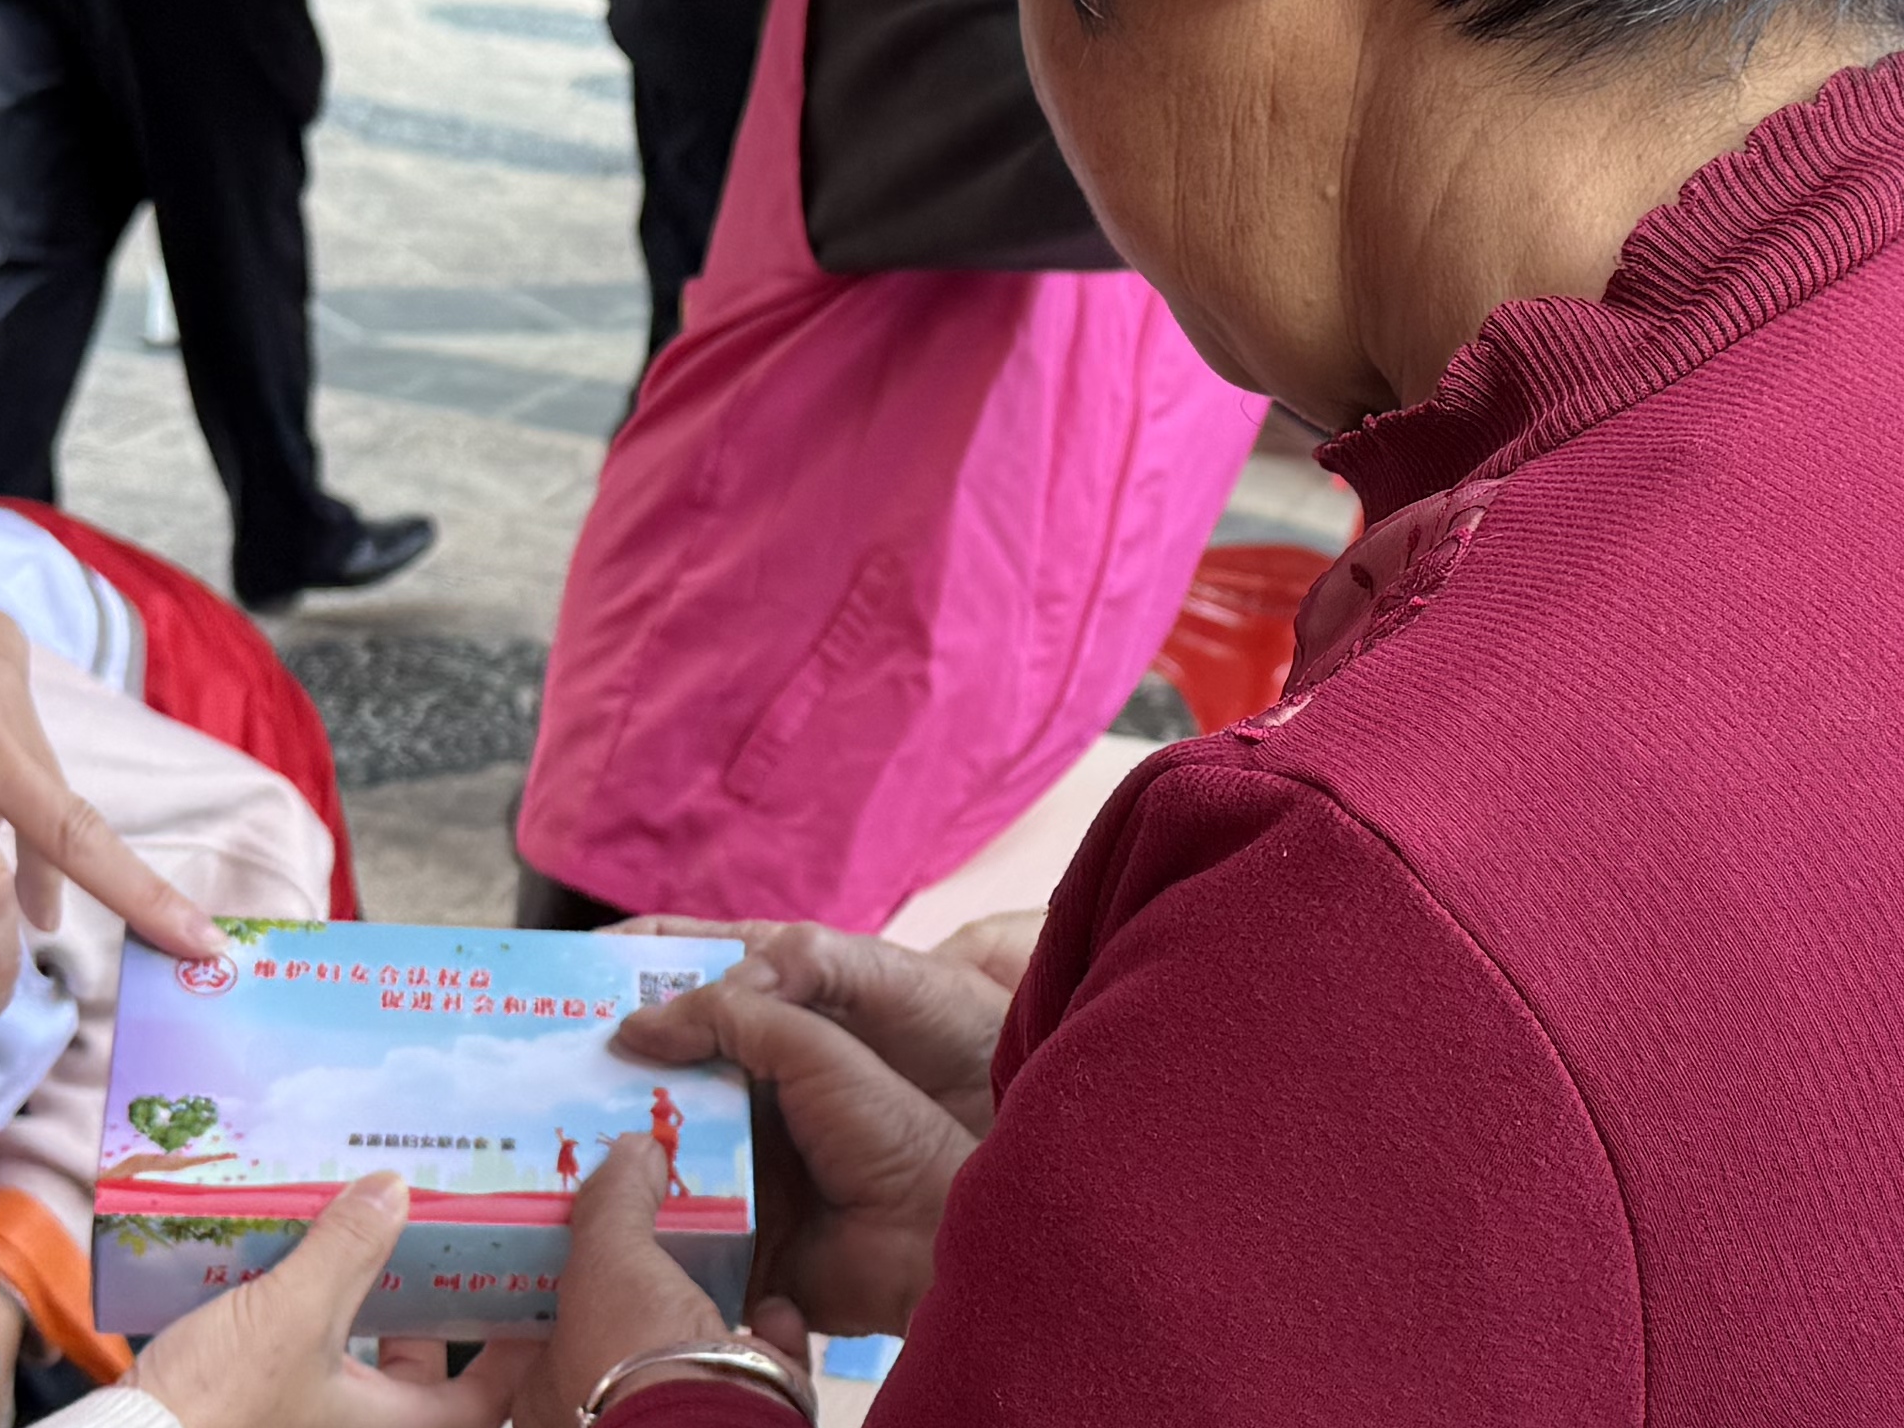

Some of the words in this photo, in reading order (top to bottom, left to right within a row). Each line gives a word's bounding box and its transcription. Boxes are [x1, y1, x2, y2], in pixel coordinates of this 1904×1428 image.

[253, 957, 492, 989] 维护妇女合法权益
[379, 989, 622, 1021] 促进社会和谐稳定
